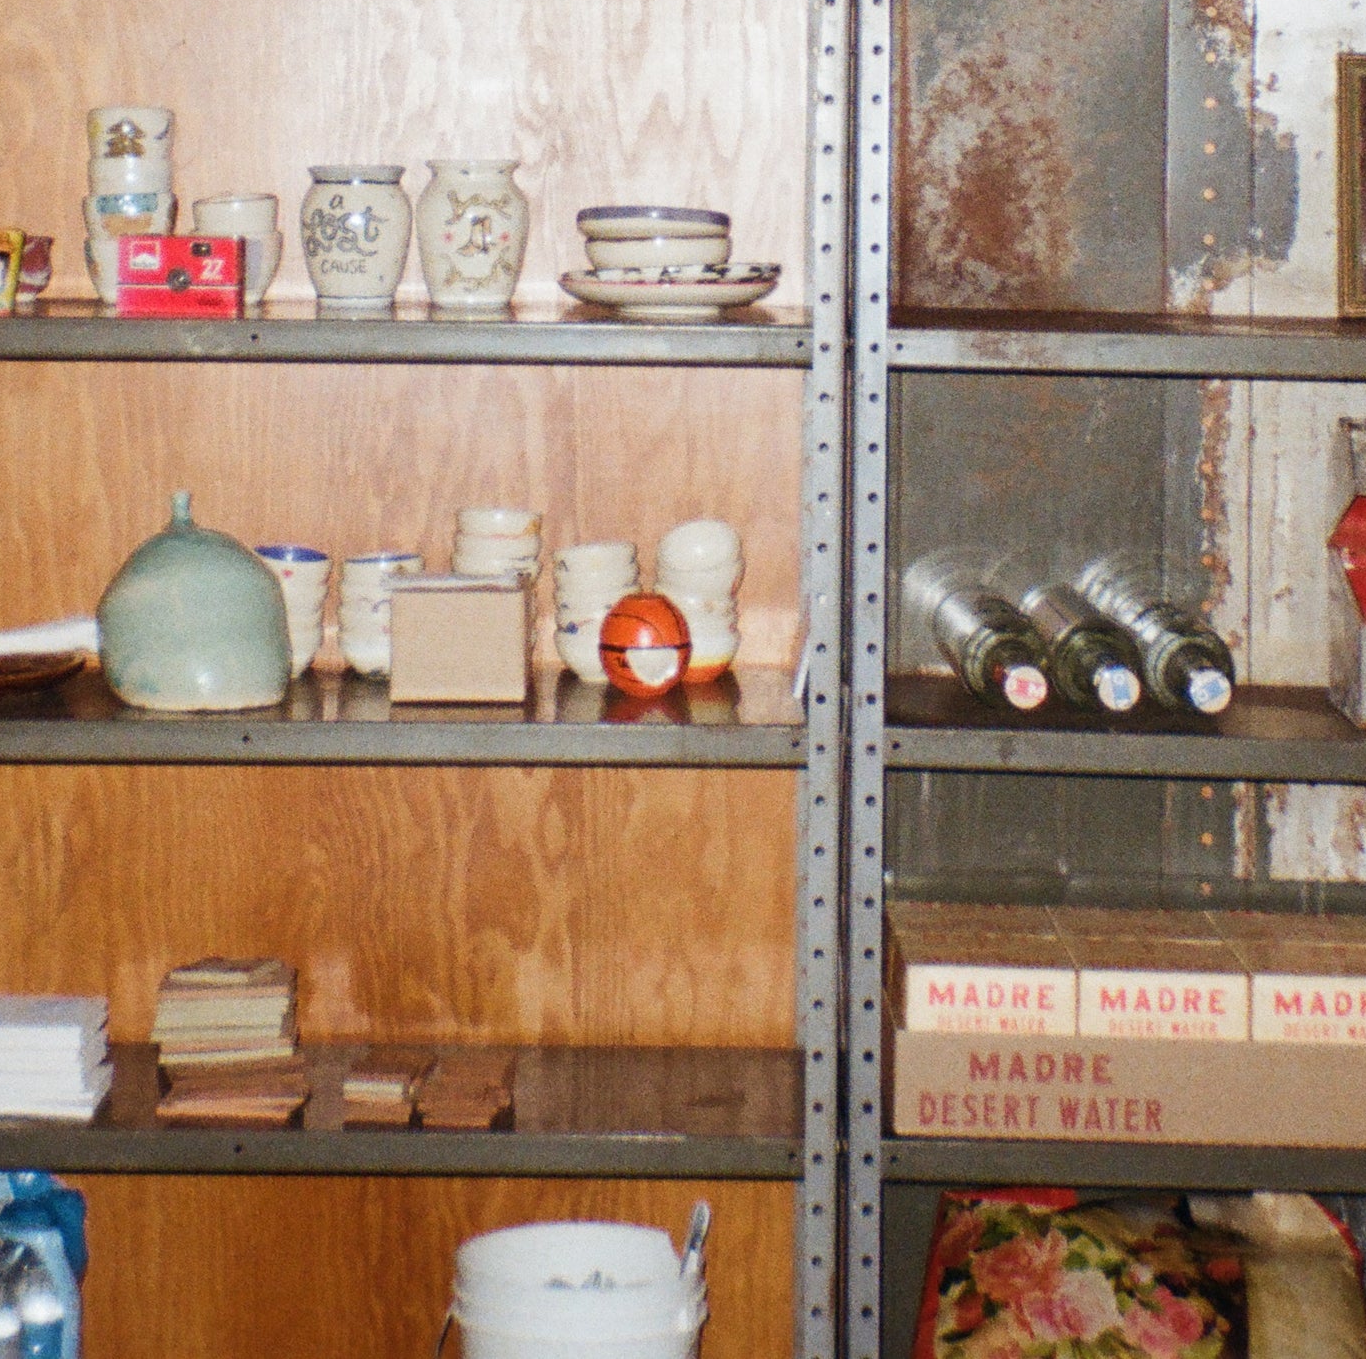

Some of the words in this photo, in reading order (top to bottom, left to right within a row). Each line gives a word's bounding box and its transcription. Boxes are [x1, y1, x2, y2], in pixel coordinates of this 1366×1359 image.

[320, 258, 368, 276] CAUSE
[929, 981, 1056, 1010] MADRE
[1099, 987, 1227, 1015] MADRE
[968, 1050, 1113, 1086] MADRE
[919, 1093, 1040, 1128] DESERT
[1058, 1094, 1163, 1134] WATER
